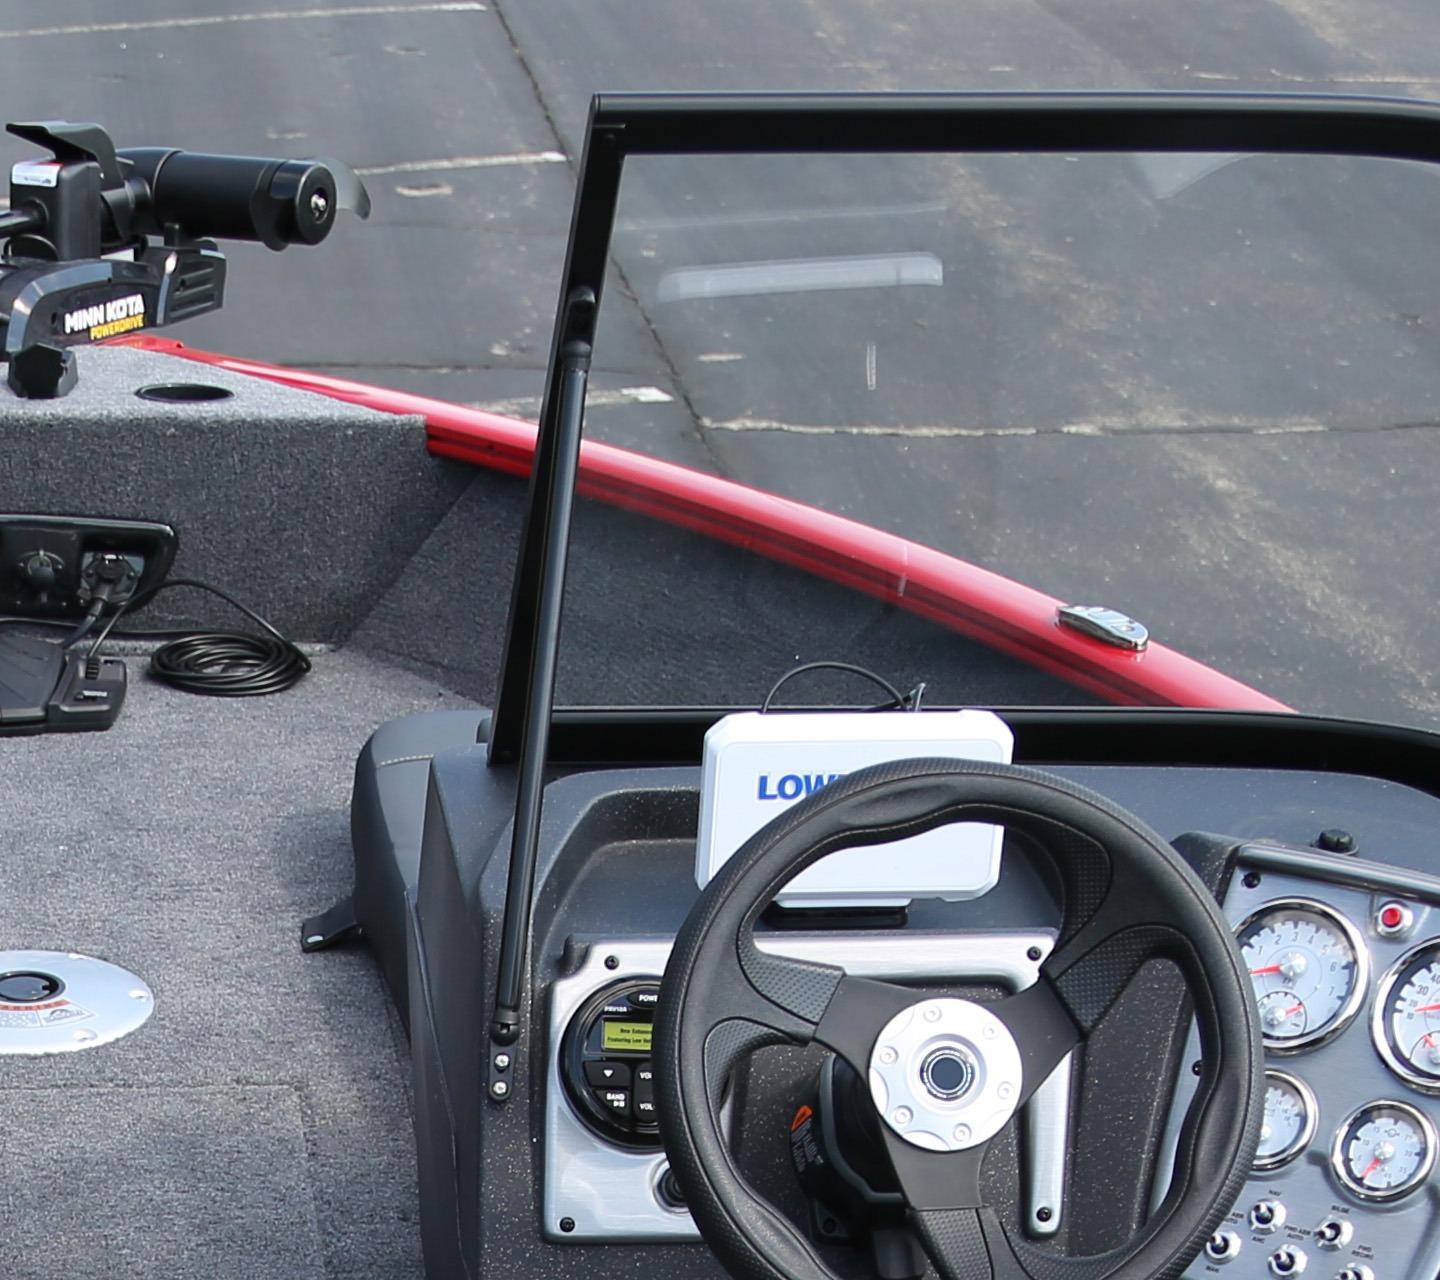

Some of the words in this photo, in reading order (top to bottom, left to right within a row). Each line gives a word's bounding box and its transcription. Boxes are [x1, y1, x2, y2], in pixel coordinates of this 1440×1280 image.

[65, 304, 105, 334] MINN
[106, 294, 144, 322] KOTA
[90, 314, 144, 340] POWERDRIVE
[757, 774, 842, 801] LOW
[638, 994, 658, 1002] POWE
[1415, 984, 1429, 996] 30
